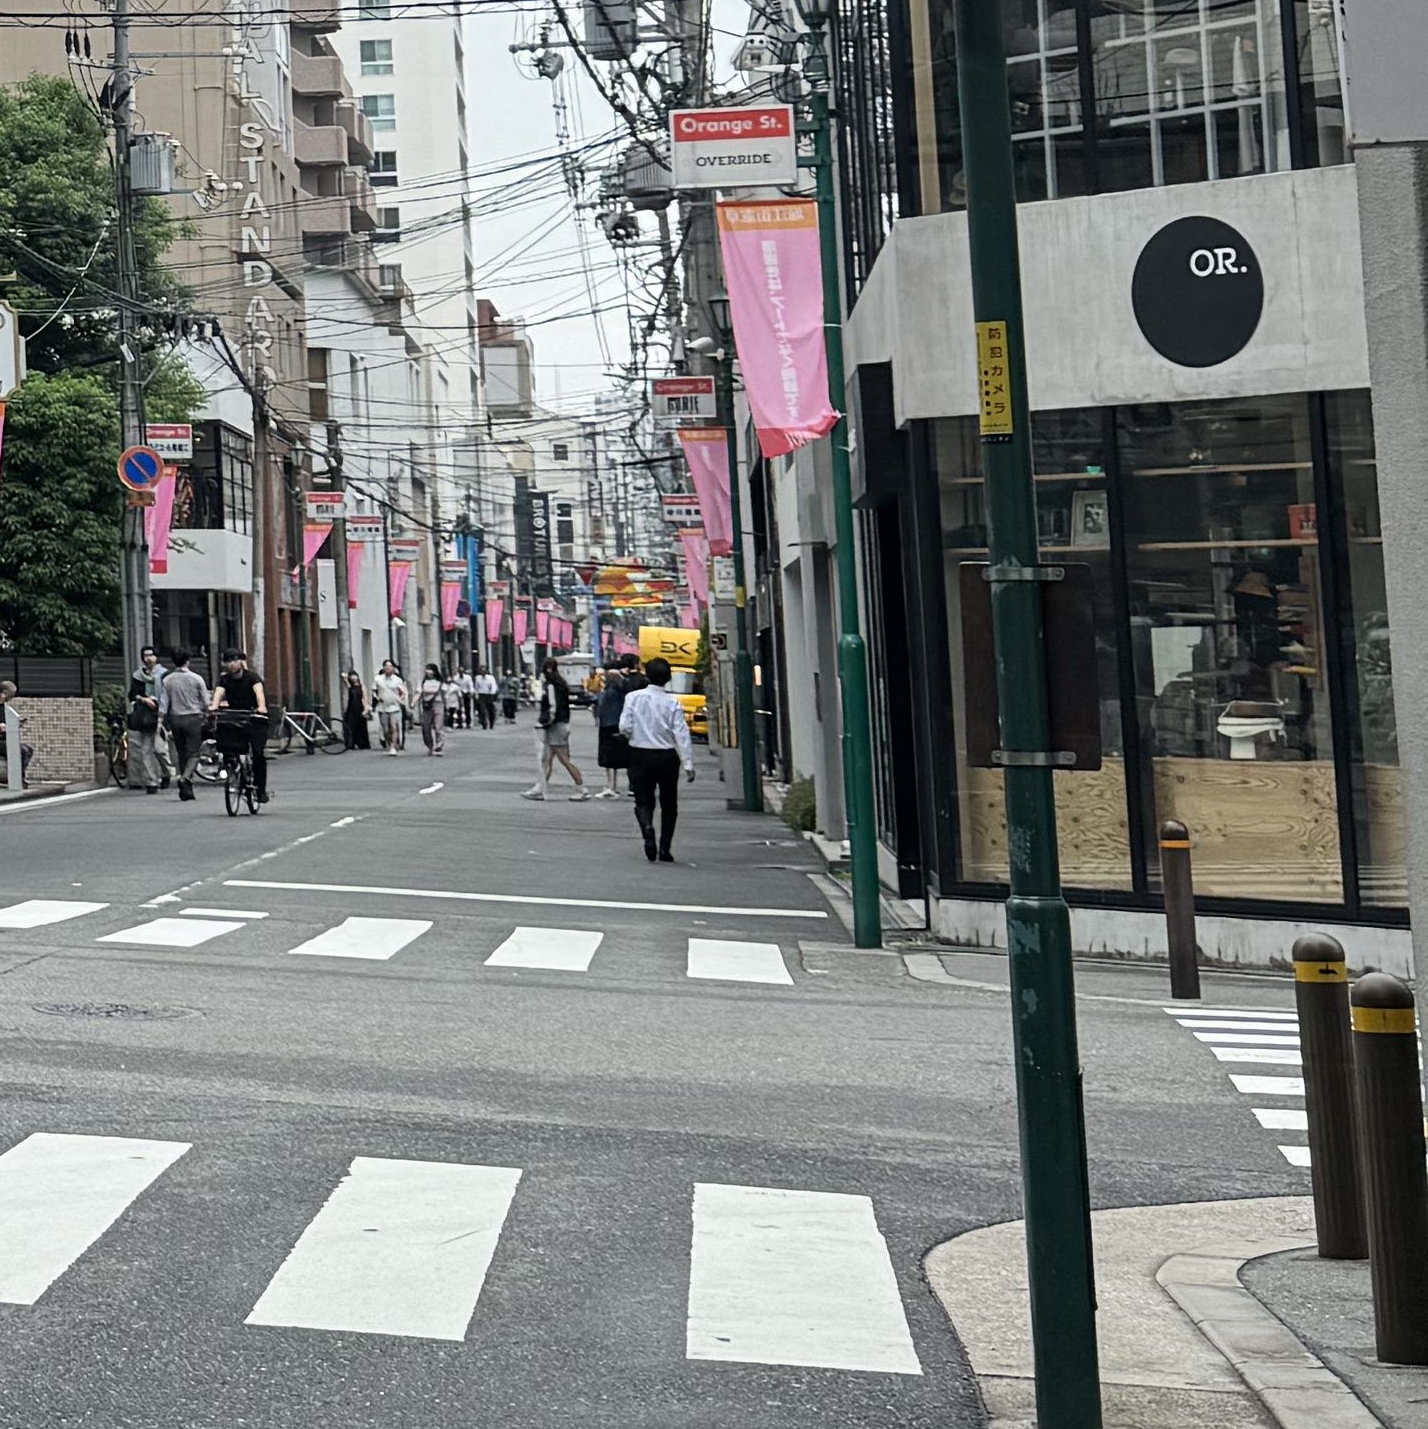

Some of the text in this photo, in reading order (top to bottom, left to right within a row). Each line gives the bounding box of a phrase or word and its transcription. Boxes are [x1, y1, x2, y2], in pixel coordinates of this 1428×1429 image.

[680, 115, 783, 134] Orange St.
[696, 153, 772, 167] OVERRIDE
[1190, 247, 1248, 277] OR.
